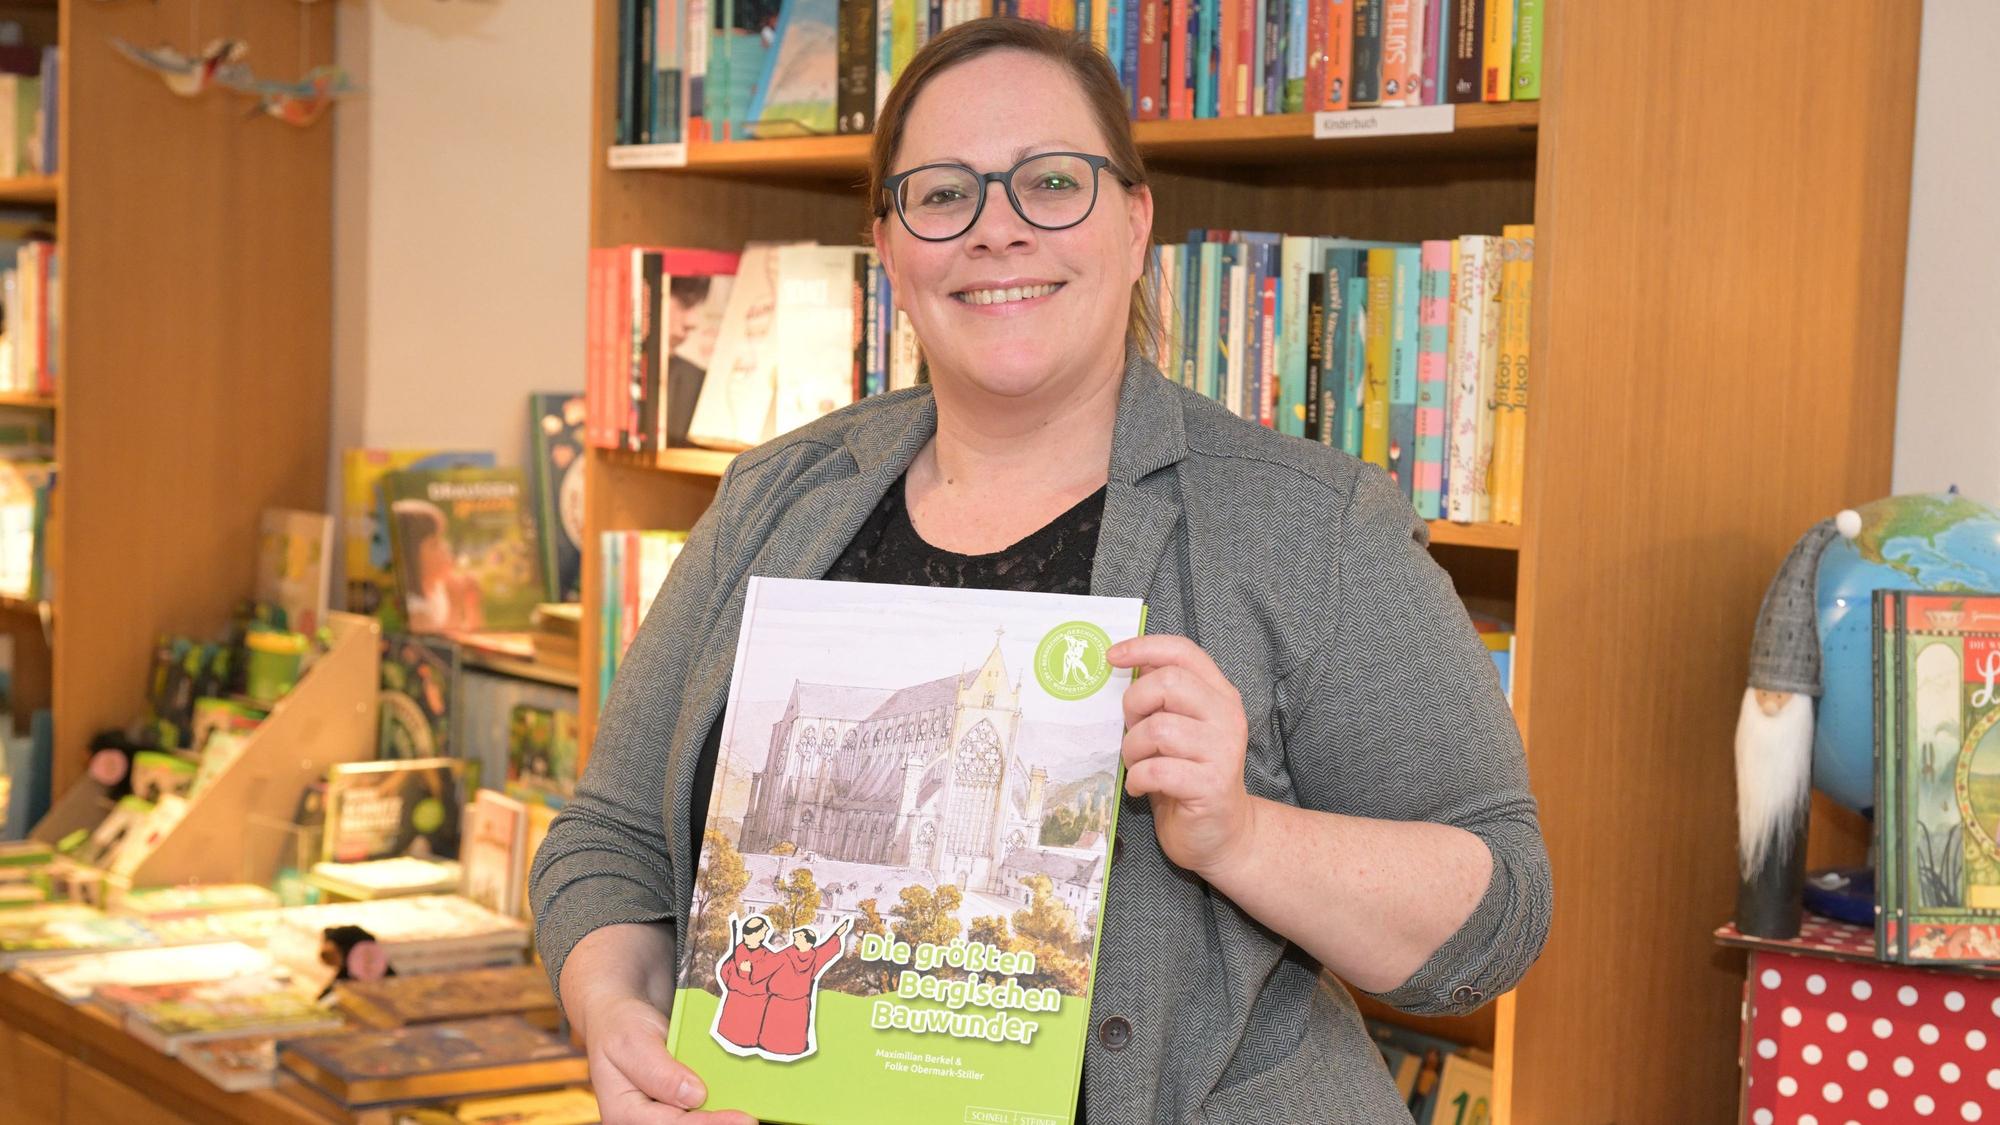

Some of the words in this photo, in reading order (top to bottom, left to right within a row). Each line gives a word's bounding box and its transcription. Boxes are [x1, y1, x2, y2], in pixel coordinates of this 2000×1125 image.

[1323, 115, 1378, 131] Kinderbuch
[1458, 253, 1475, 314] Anni
[1488, 353, 1512, 414] Jakob
[1512, 355, 1530, 414] Jakob
[861, 933, 910, 963] Die
[915, 940, 1035, 975] größten
[898, 970, 1061, 1011] Bergischen
[873, 1002, 1038, 1044] Bauwunder
[875, 1048, 923, 1062] Maximilian
[925, 1054, 954, 1065] Berkel
[955, 1057, 963, 1066] &
[885, 1061, 909, 1072] Folke
[911, 1064, 985, 1081] Obermark-Stiller
[971, 1111, 1008, 1124] SCHNELL
